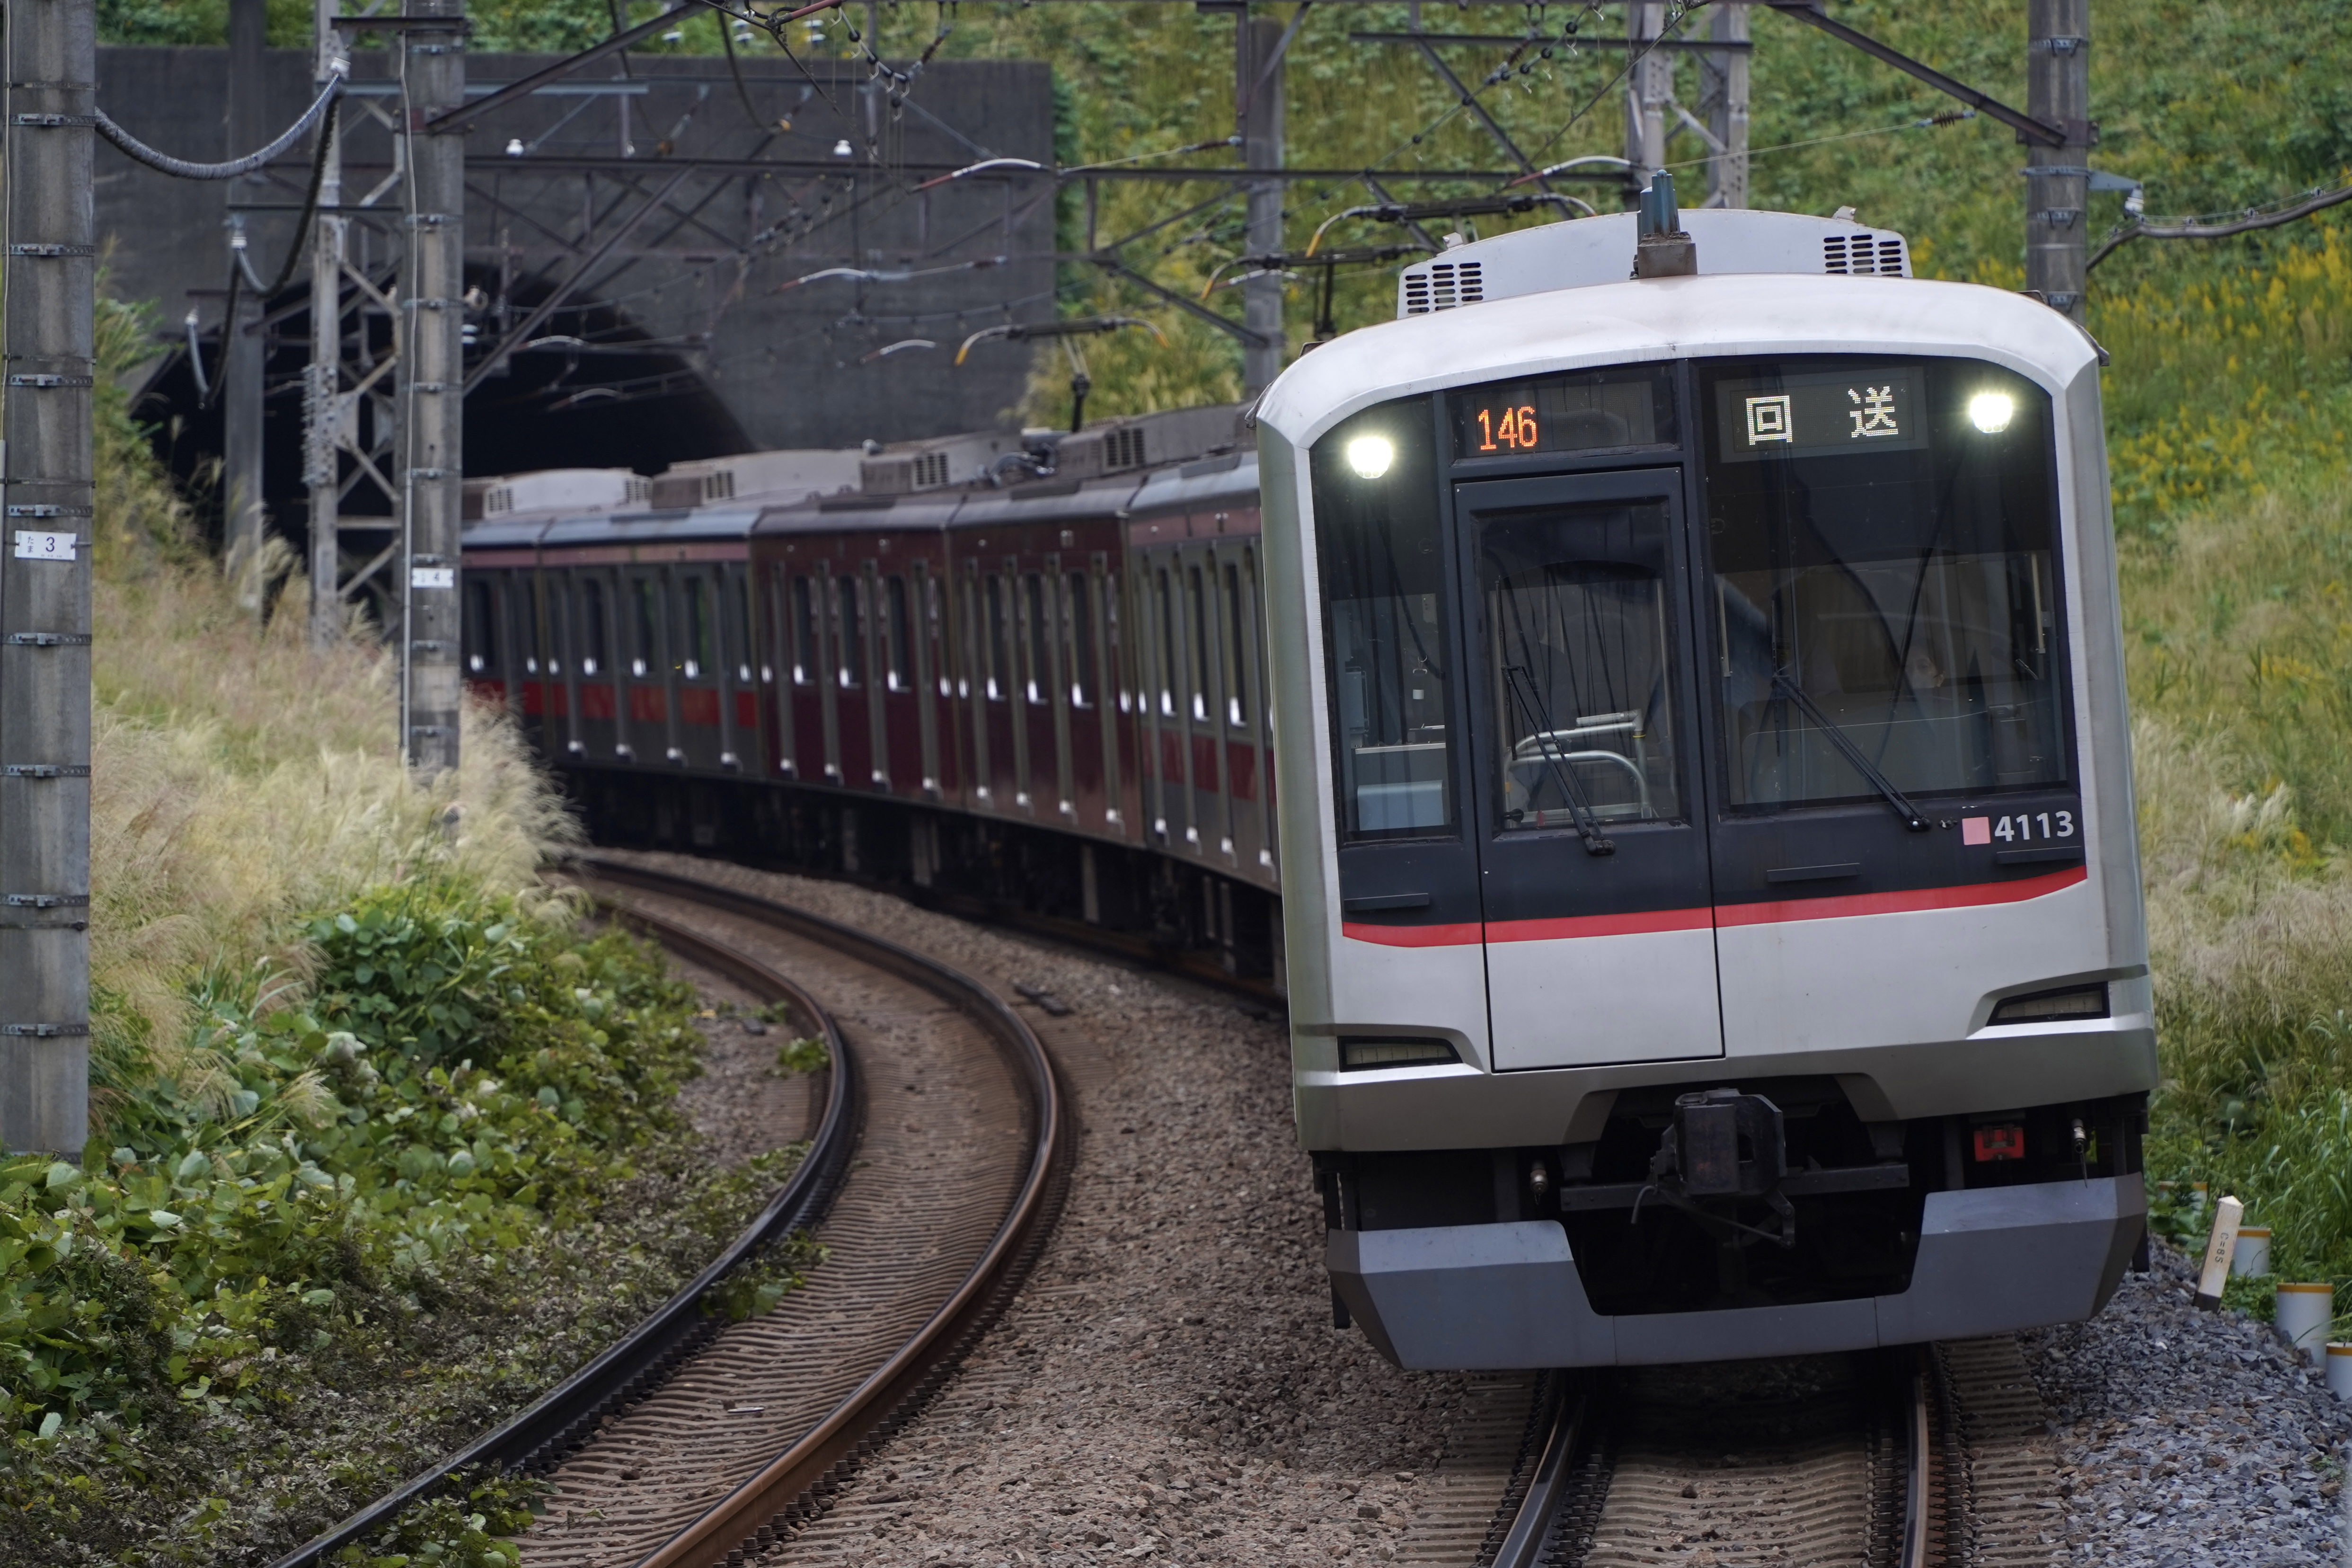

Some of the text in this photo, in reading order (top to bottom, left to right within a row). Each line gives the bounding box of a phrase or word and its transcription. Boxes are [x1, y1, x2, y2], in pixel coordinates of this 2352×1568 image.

[1478, 406, 1537, 450] 146
[1746, 386, 1899, 445] 回送
[27, 536, 35, 553] たま
[46, 537, 55, 552] 3
[1994, 810, 2074, 842] 4113
[2215, 1232, 2229, 1263] C=85
